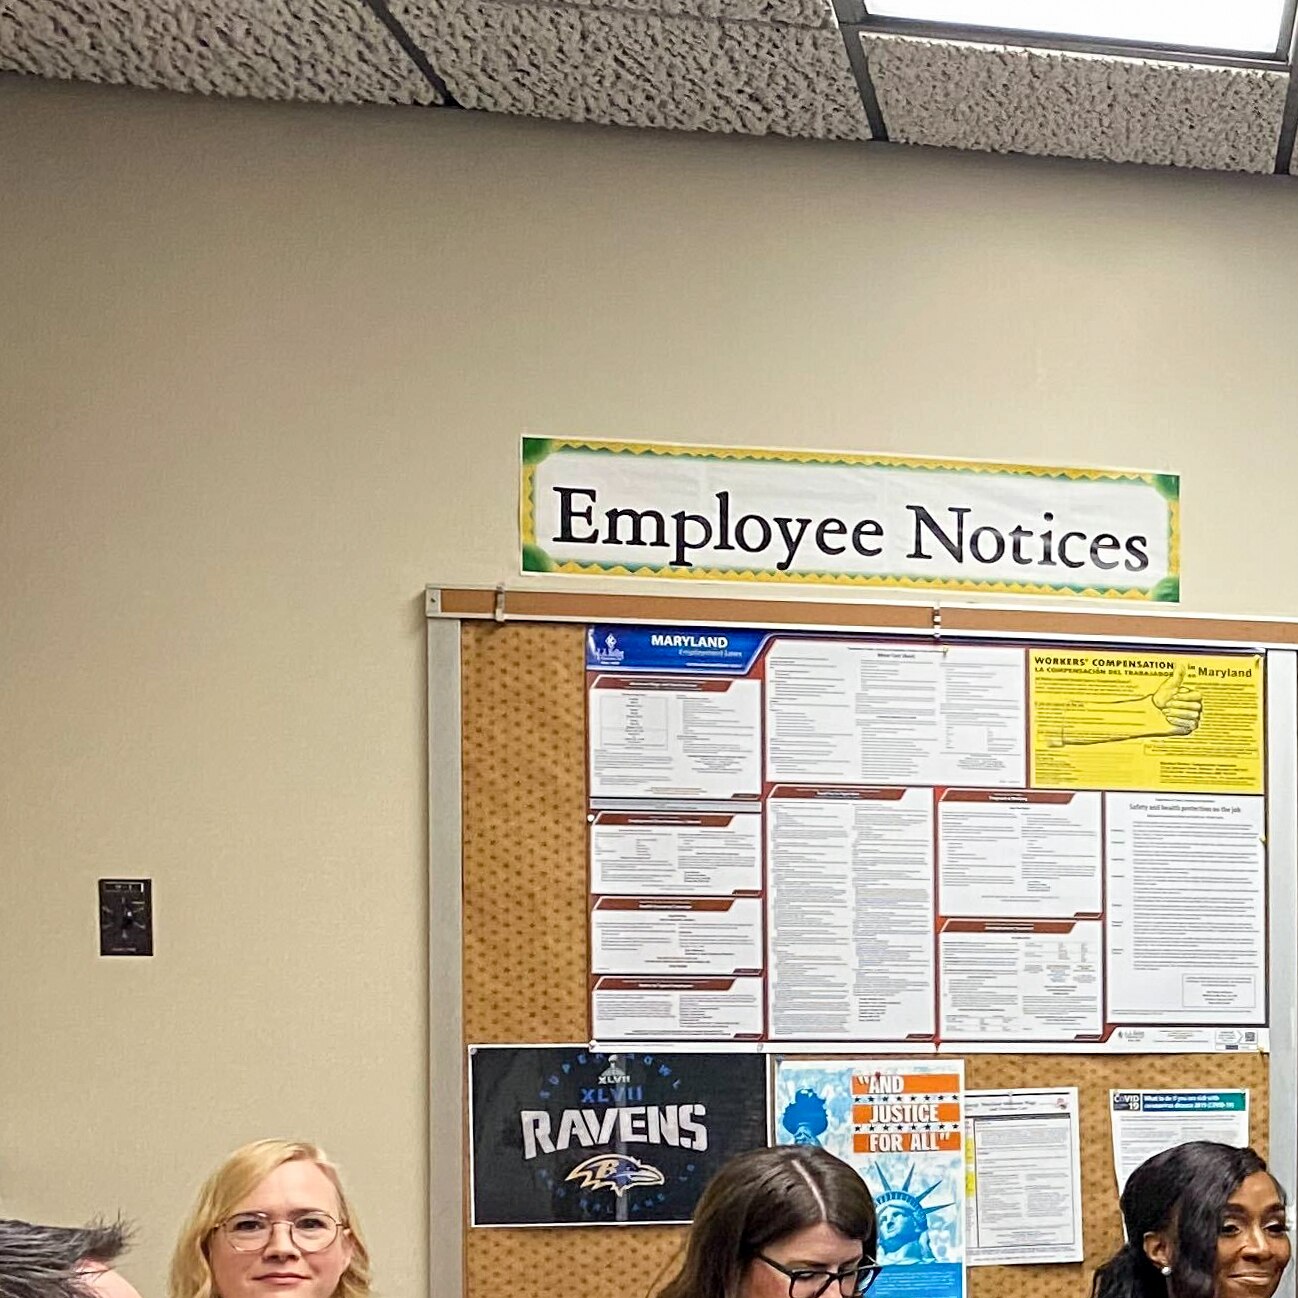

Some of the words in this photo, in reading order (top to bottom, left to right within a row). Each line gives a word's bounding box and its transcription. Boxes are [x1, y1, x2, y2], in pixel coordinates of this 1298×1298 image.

[552, 486, 884, 571] Employee
[906, 505, 1149, 572] Notices
[651, 635, 728, 649] MARYLAND
[1034, 656, 1089, 666] WORKERS'
[1092, 658, 1174, 670] COMPENSATION
[1198, 666, 1252, 678] Maryland
[598, 1075, 631, 1085] XLVII
[857, 1075, 905, 1094] "AND
[581, 1085, 644, 1104] XLVII
[1114, 1094, 1140, 1103] COVID
[869, 1104, 939, 1123] JUSTICE
[1129, 1102, 1139, 1110] 19
[520, 1103, 708, 1160] RAVENS
[869, 1133, 904, 1152] FOR
[910, 1133, 950, 1151] ALL"
